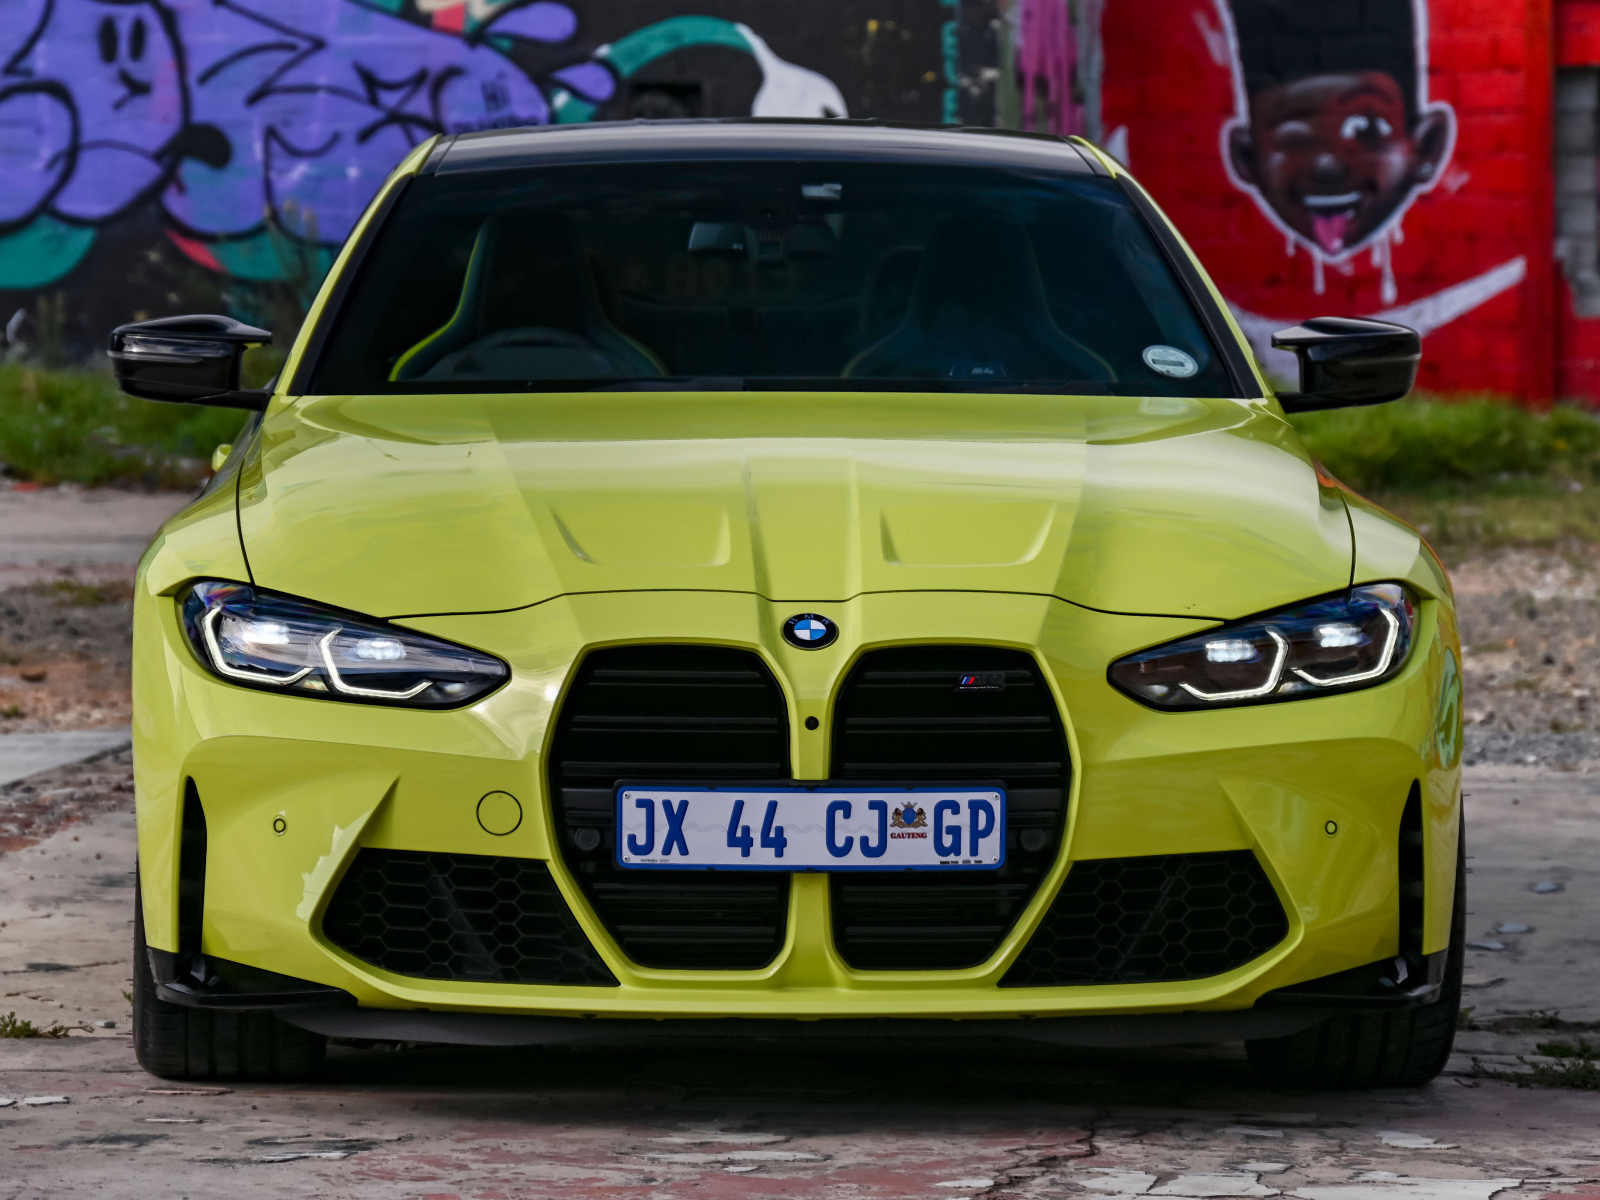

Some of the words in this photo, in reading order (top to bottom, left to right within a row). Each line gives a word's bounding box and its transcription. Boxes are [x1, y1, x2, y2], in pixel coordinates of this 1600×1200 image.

[788, 613, 832, 625] BMW
[627, 798, 690, 857] JX
[727, 799, 787, 858] 44
[825, 799, 888, 858] CJ
[933, 798, 996, 858] GP
